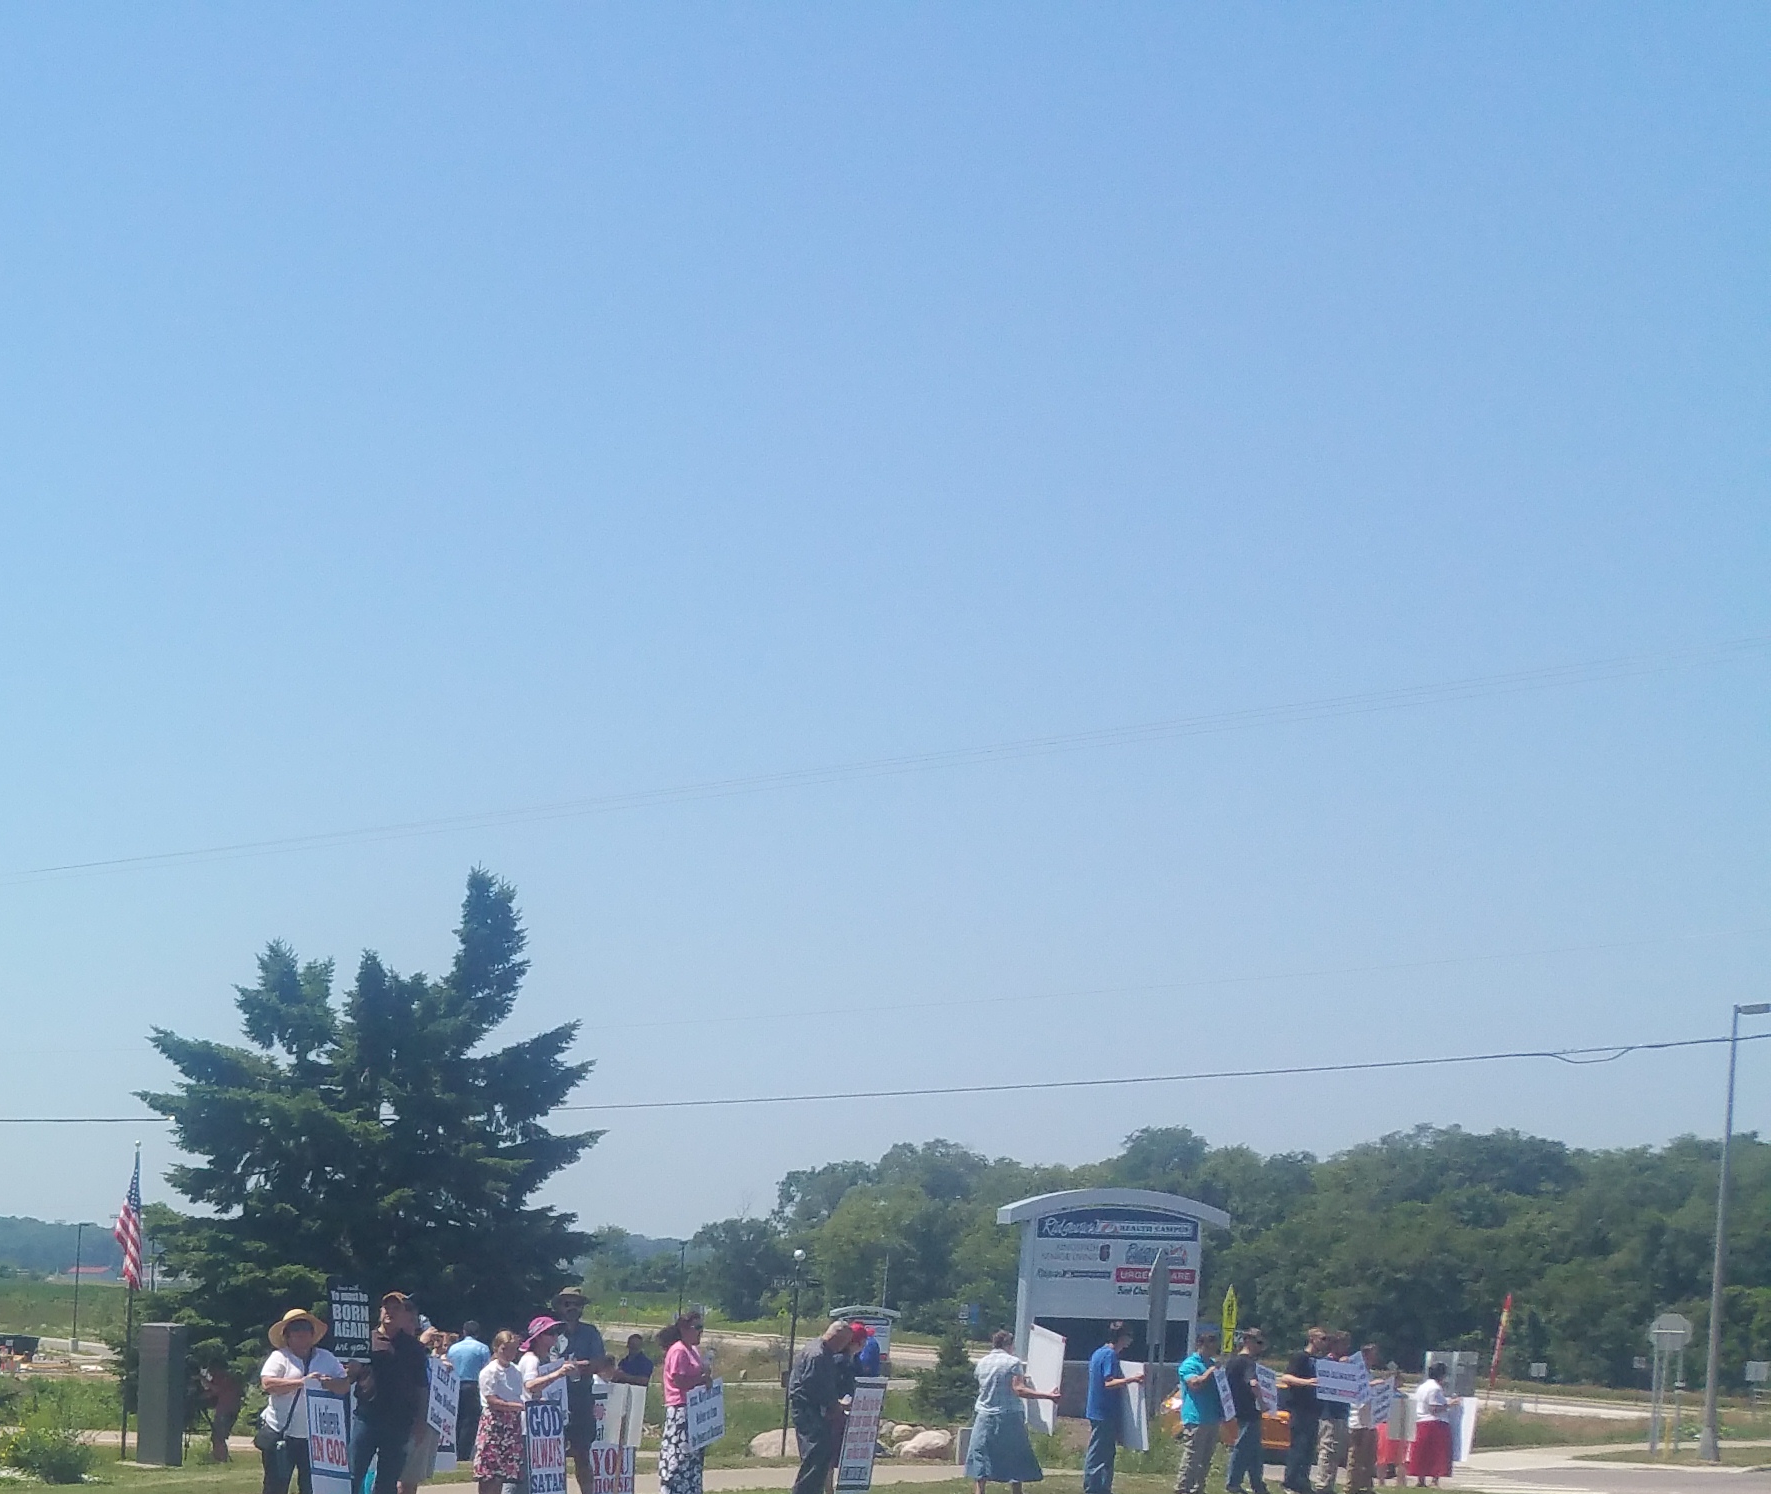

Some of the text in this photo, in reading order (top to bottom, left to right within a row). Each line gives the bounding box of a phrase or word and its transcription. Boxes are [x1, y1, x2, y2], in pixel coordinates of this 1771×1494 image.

[1119, 1225, 1152, 1233] HEALTH
[1154, 1226, 1190, 1234] CAMPUS
[1120, 1270, 1151, 1280] URGE
[1170, 1270, 1191, 1280] ARE
[332, 1303, 369, 1322] BORN
[334, 1321, 370, 1338] AGAIN
[314, 1403, 319, 1434] I
[529, 1406, 563, 1437] GOD
[312, 1435, 347, 1467] IN GOD
[592, 1448, 629, 1476] YOU
[531, 1473, 566, 1493] SATAN
